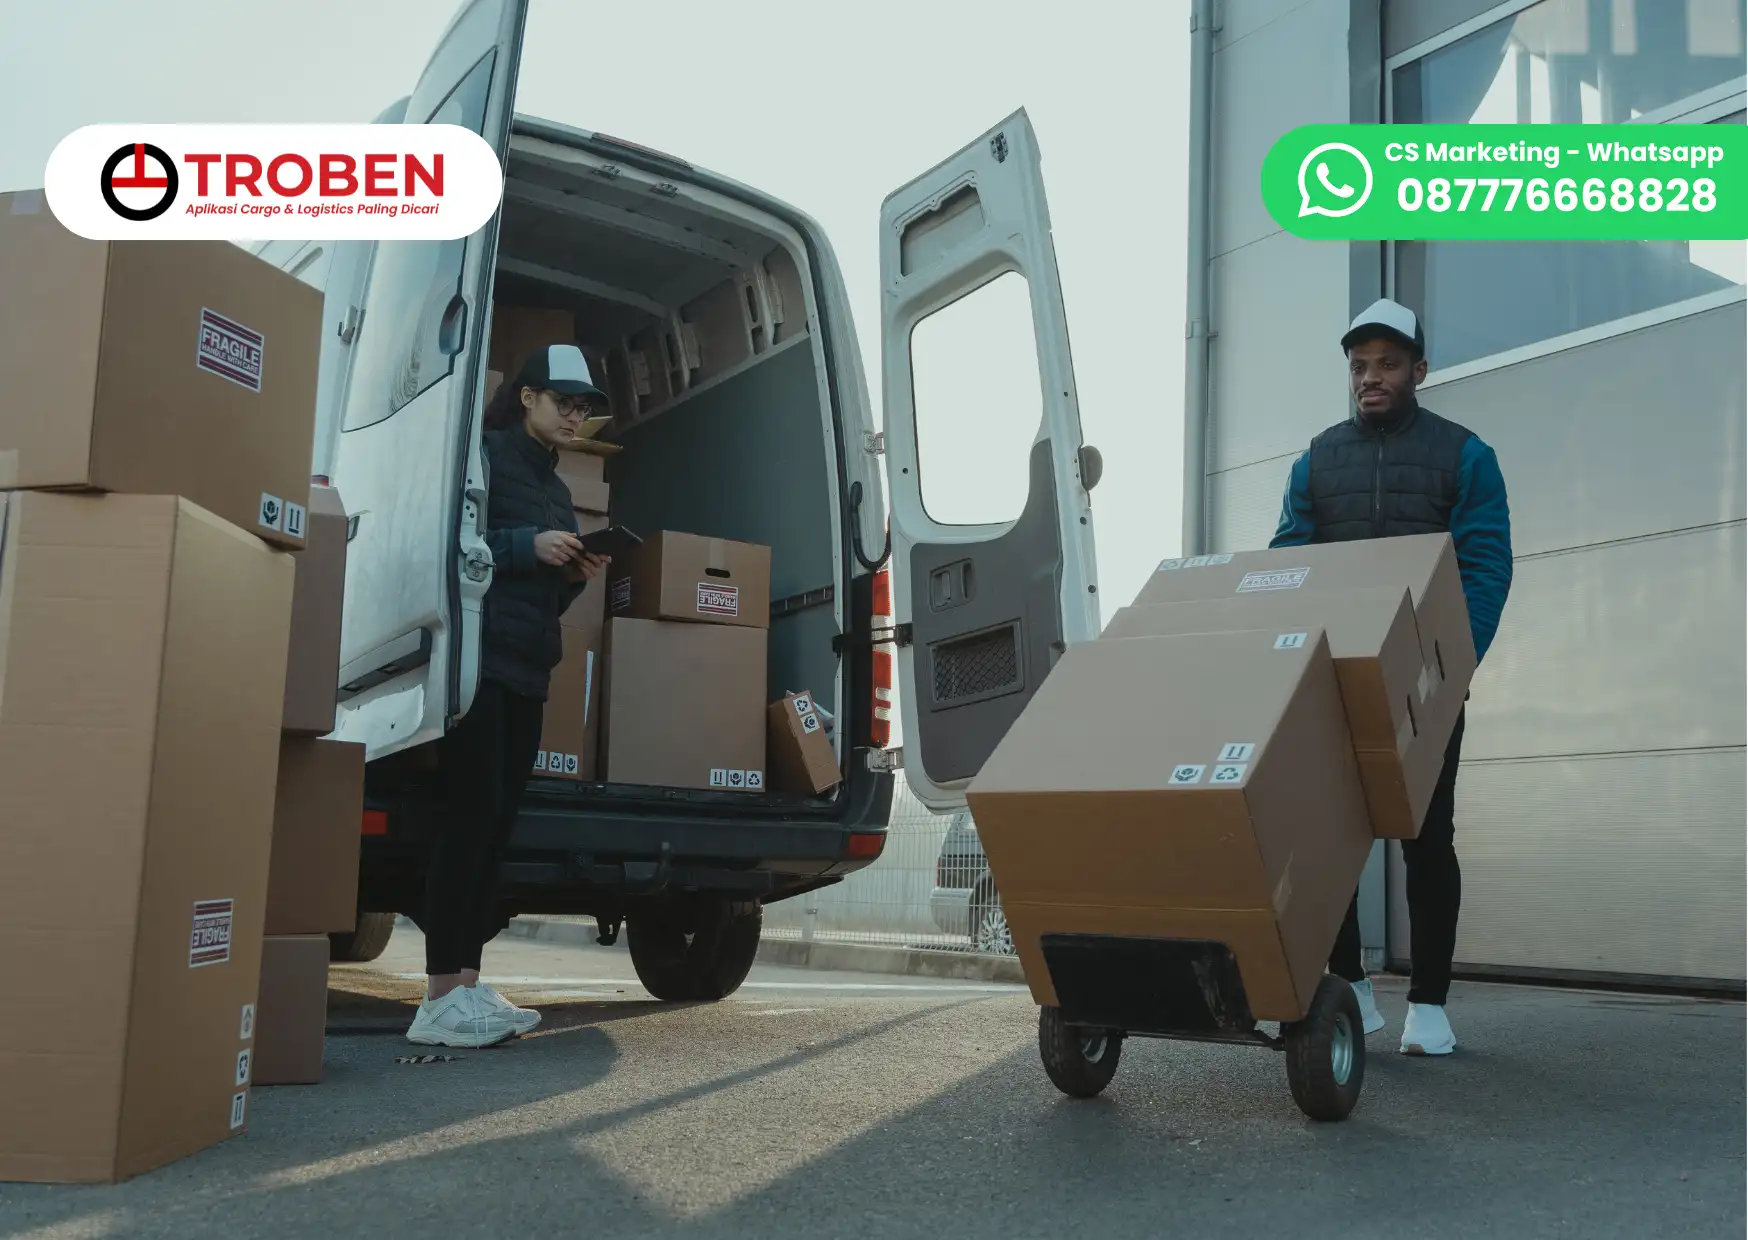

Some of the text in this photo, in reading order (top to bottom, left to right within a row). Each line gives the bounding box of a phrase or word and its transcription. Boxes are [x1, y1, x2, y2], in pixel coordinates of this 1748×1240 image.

[202, 327, 260, 367] FRAGILE
[201, 344, 259, 374] HANDLE WITH CARE
[1243, 573, 1303, 586] FRAGILE
[700, 595, 736, 607] FRAGILE
[194, 924, 231, 947] FRAGILE
